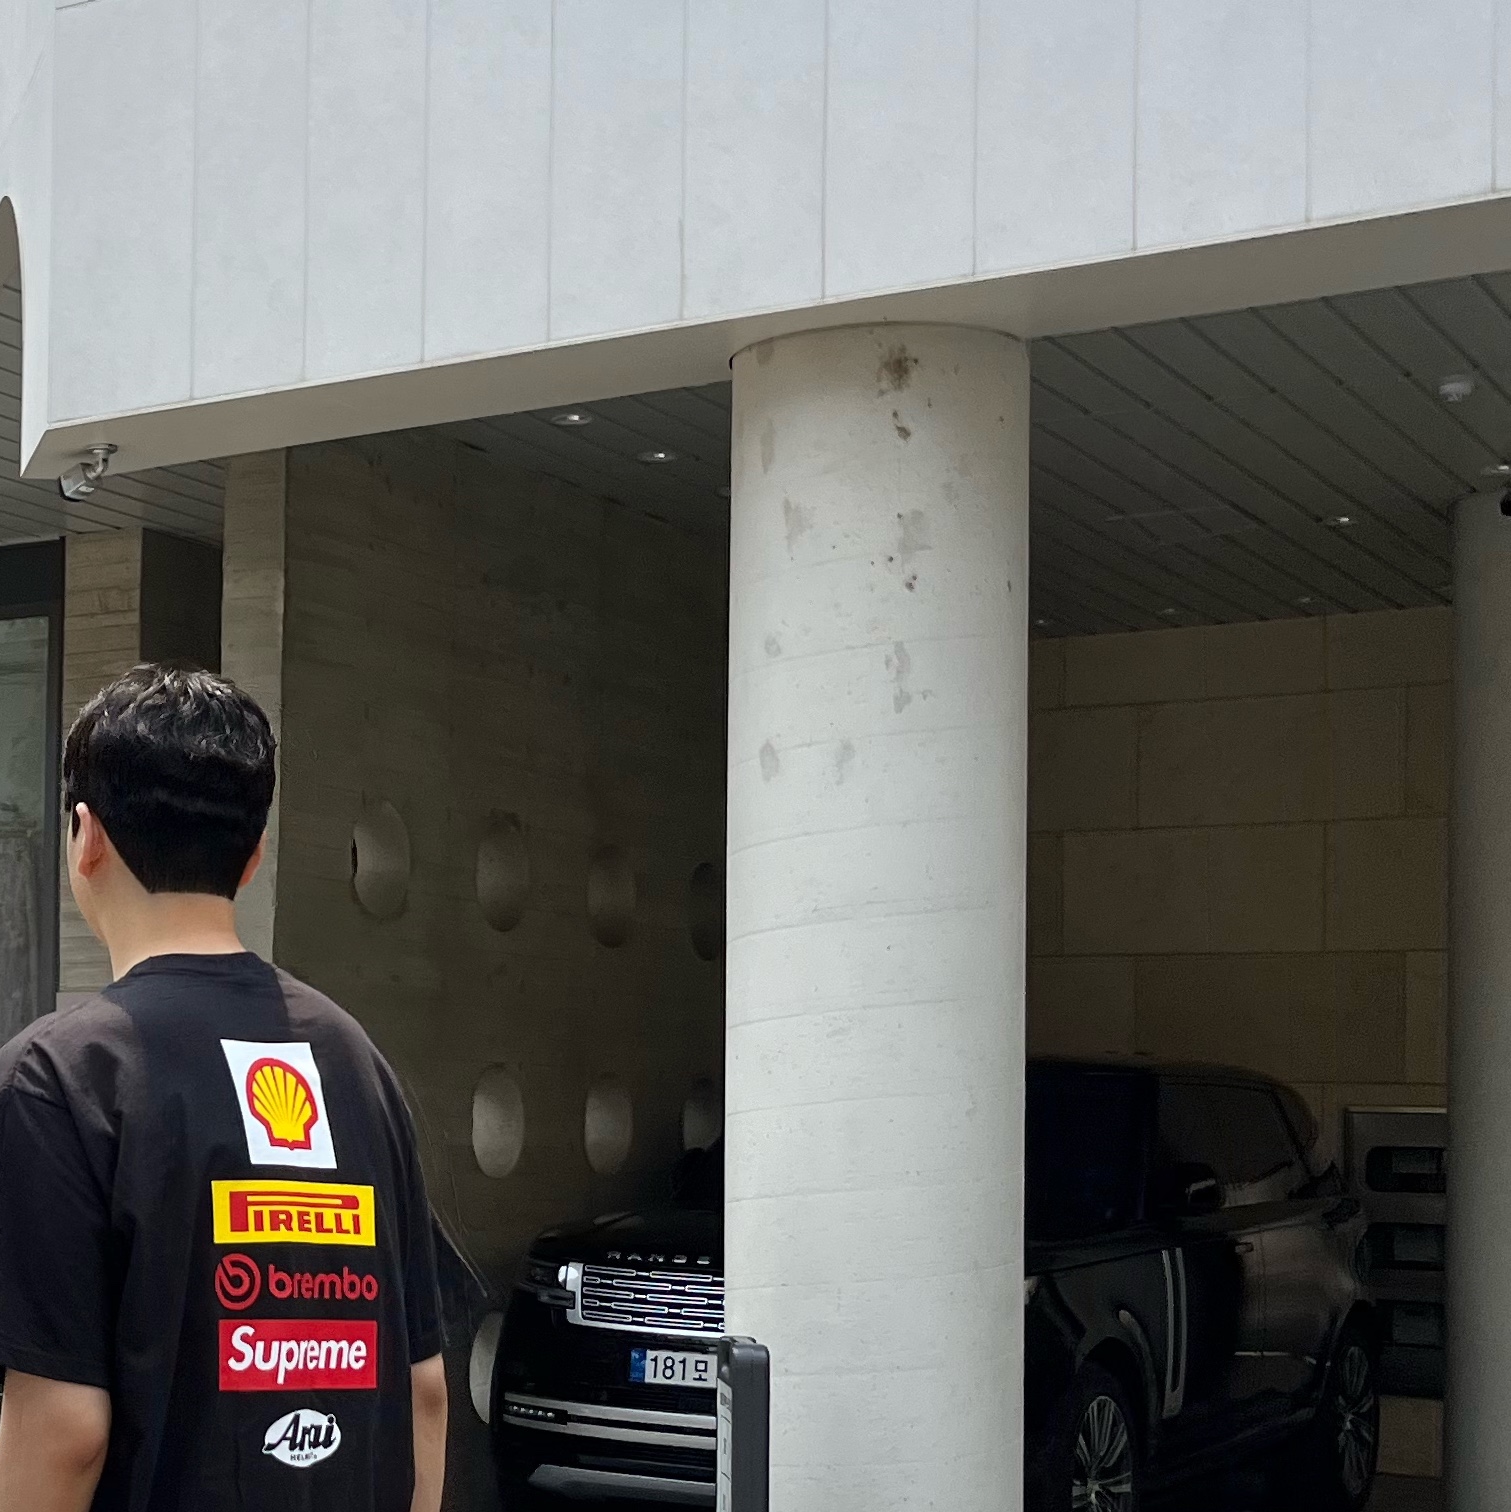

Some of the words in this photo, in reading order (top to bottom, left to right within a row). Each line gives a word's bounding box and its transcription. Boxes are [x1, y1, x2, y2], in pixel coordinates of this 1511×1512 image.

[229, 1191, 362, 1236] PIRELLI
[267, 1263, 379, 1301] brembo
[227, 1325, 368, 1385] Supreme
